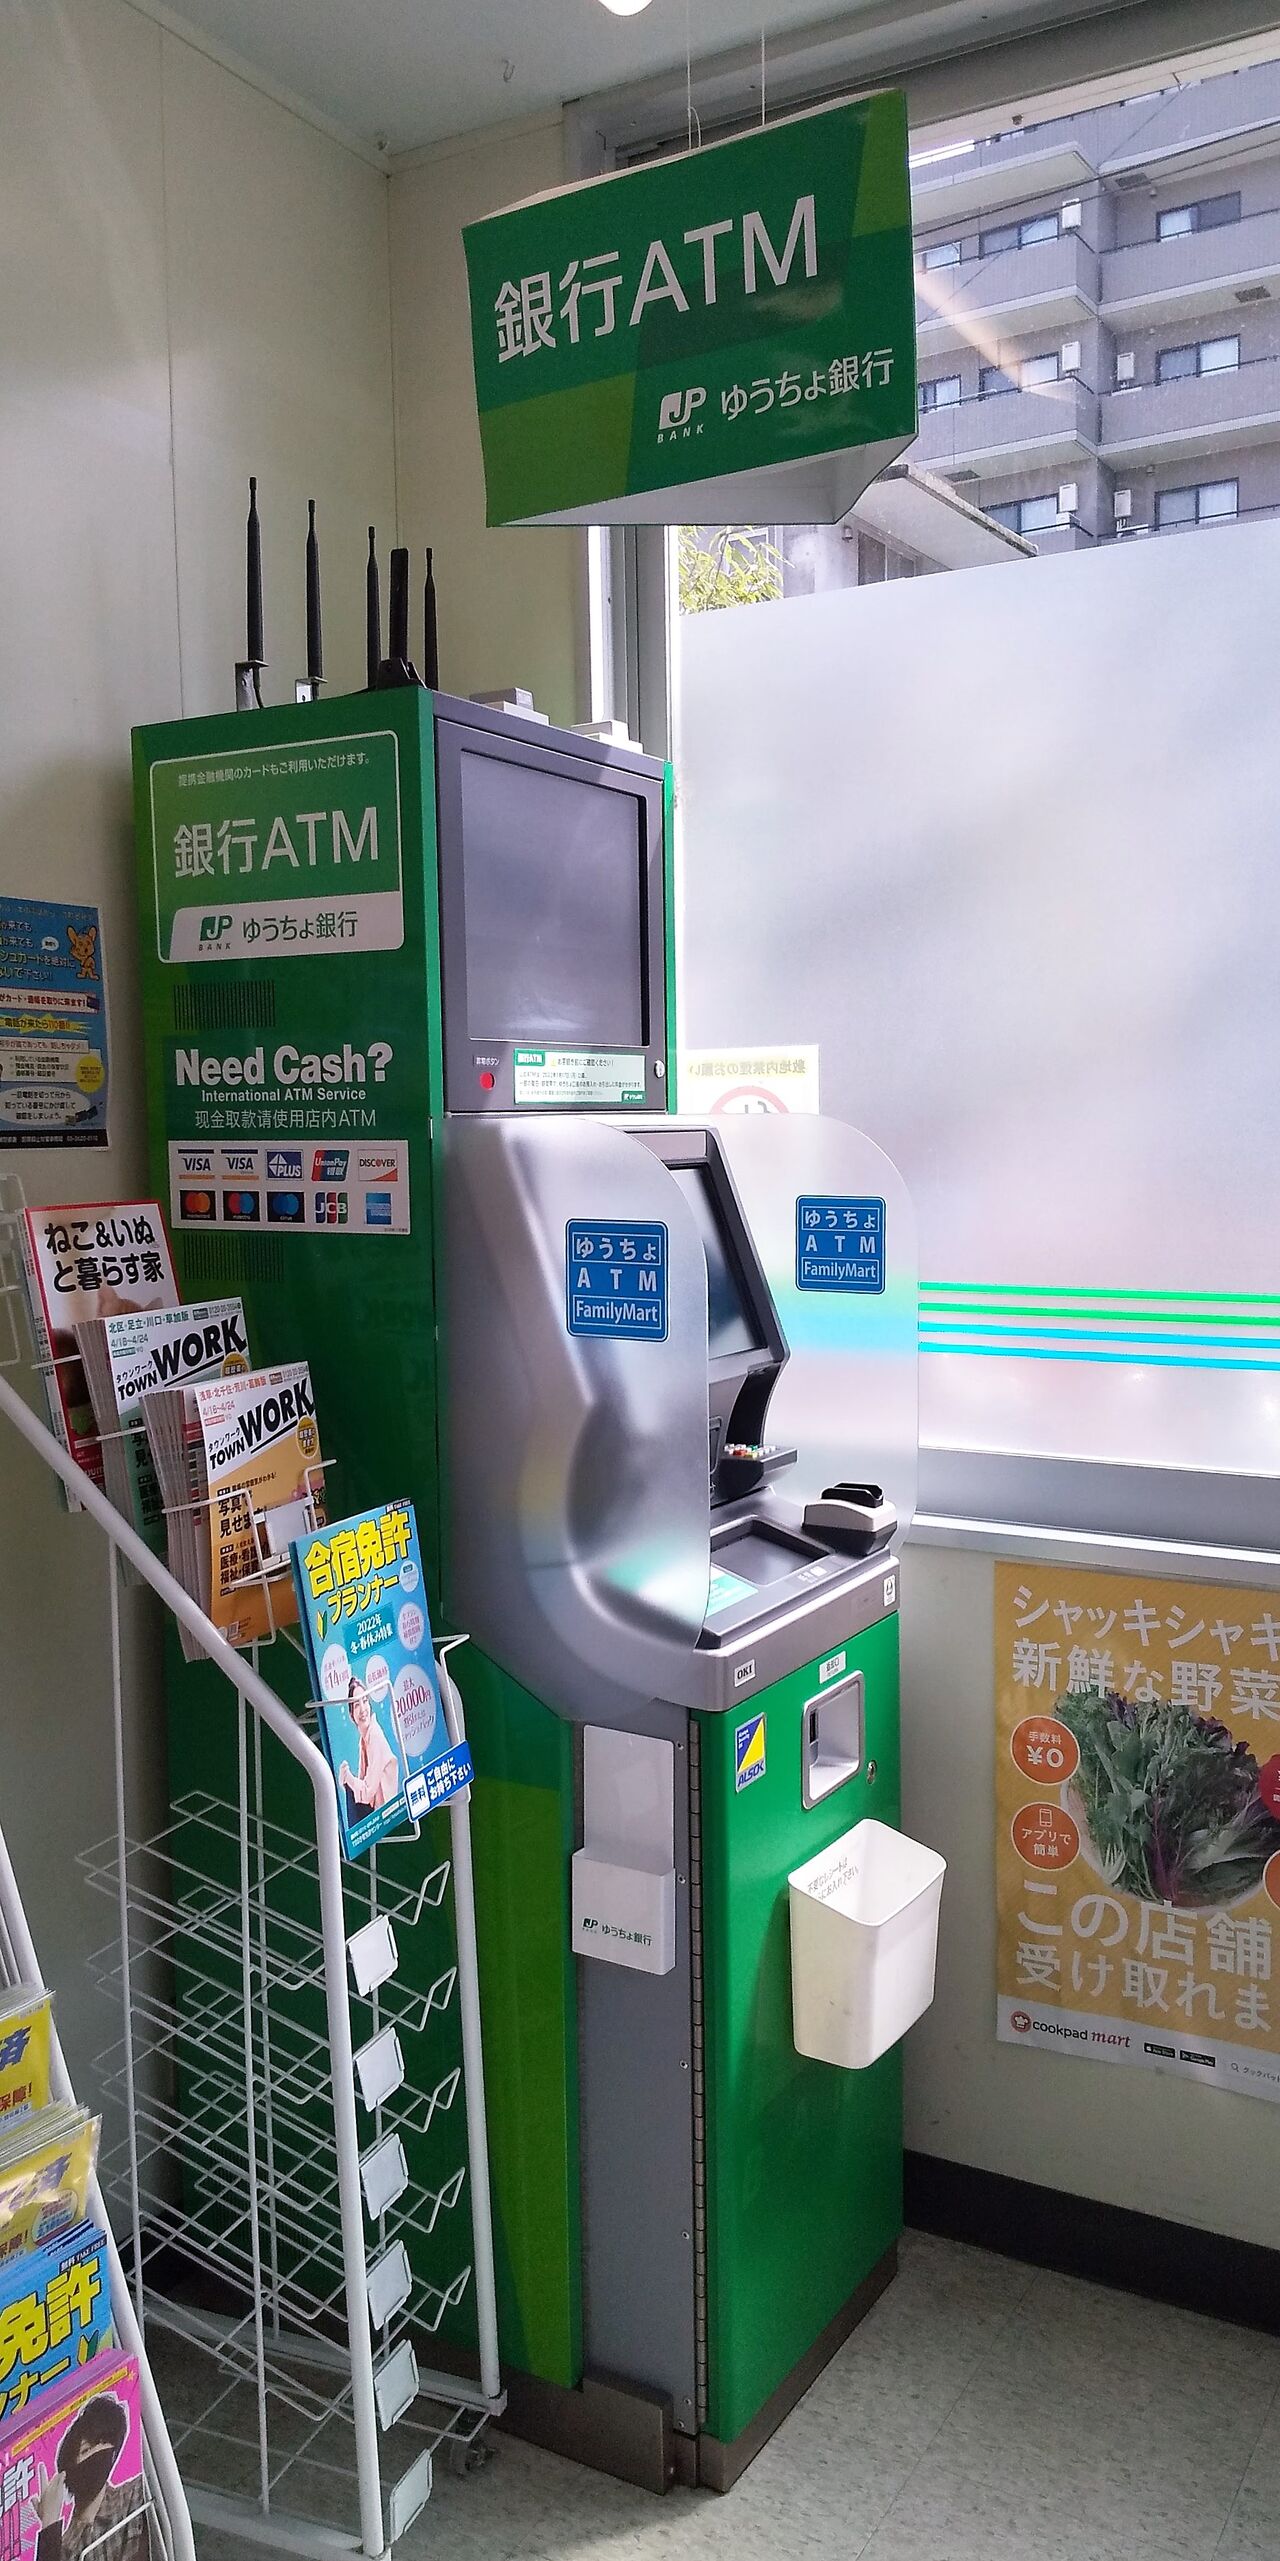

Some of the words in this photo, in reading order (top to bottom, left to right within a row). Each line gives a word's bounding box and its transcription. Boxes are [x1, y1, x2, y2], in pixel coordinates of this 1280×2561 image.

[494, 194, 819, 364] 銀行ATM
[721, 347, 895, 421] ゆうちょ銀行
[656, 424, 704, 444] BANK
[174, 806, 379, 879] 銀行ATM
[242, 911, 358, 944] ゆうちょ銀行
[199, 943, 231, 952] BANK
[175, 1046, 265, 1086] Need
[273, 1042, 394, 1085] Cash?
[202, 1089, 280, 1103] International
[284, 1088, 313, 1101] ATM
[317, 1087, 367, 1101] Service
[195, 1109, 377, 1129] 现金取款请使用店内ATM
[182, 1157, 211, 1172] VISA
[226, 1156, 254, 1171] VISA
[278, 1165, 301, 1178] PLUS
[314, 1157, 347, 1169] UnionPay
[359, 1158, 396, 1168] DISCOVER
[315, 1202, 348, 1214] JCB
[804, 1209, 876, 1229] ゆうちょ
[44, 1215, 156, 1255] ねこ&いぬ
[576, 1237, 657, 1262] ゆうちょ
[53, 1251, 165, 1293] と暮らす家
[804, 1261, 877, 1280] FamilyMart
[576, 1301, 658, 1324] FamilyMart
[117, 1370, 158, 1400] TOWN
[150, 1314, 248, 1381] WORK
[116, 1360, 153, 1383] タウンワーク
[210, 1437, 245, 1470] TOWN
[238, 1377, 316, 1448] WORK
[208, 1427, 241, 1452] タウンワーク
[304, 1511, 411, 1599] 合宿免許
[327, 1575, 399, 1624] プランナー
[356, 1613, 382, 1636] 2022年
[737, 1663, 753, 1680] OKI
[1012, 1637, 1280, 1722] 新鮮な野菜
[1028, 1730, 1062, 1745] 手数料
[1026, 1744, 1065, 1769] ¥0
[426, 1757, 456, 1786] ご自由に
[429, 1763, 472, 1800] お持ち下さい
[738, 1761, 764, 1787] ALSOK
[410, 1785, 427, 1806] 無料
[1022, 1828, 1072, 1845] アプリで
[1033, 1843, 1060, 1857] 簡単
[602, 1924, 652, 1946] ゆうちょ銀行
[1017, 1879, 1273, 1981] この店舗
[1016, 1941, 1272, 2032] 受け取れま
[1032, 2019, 1088, 2041] cookpad
[1091, 2030, 1131, 2048] mart
